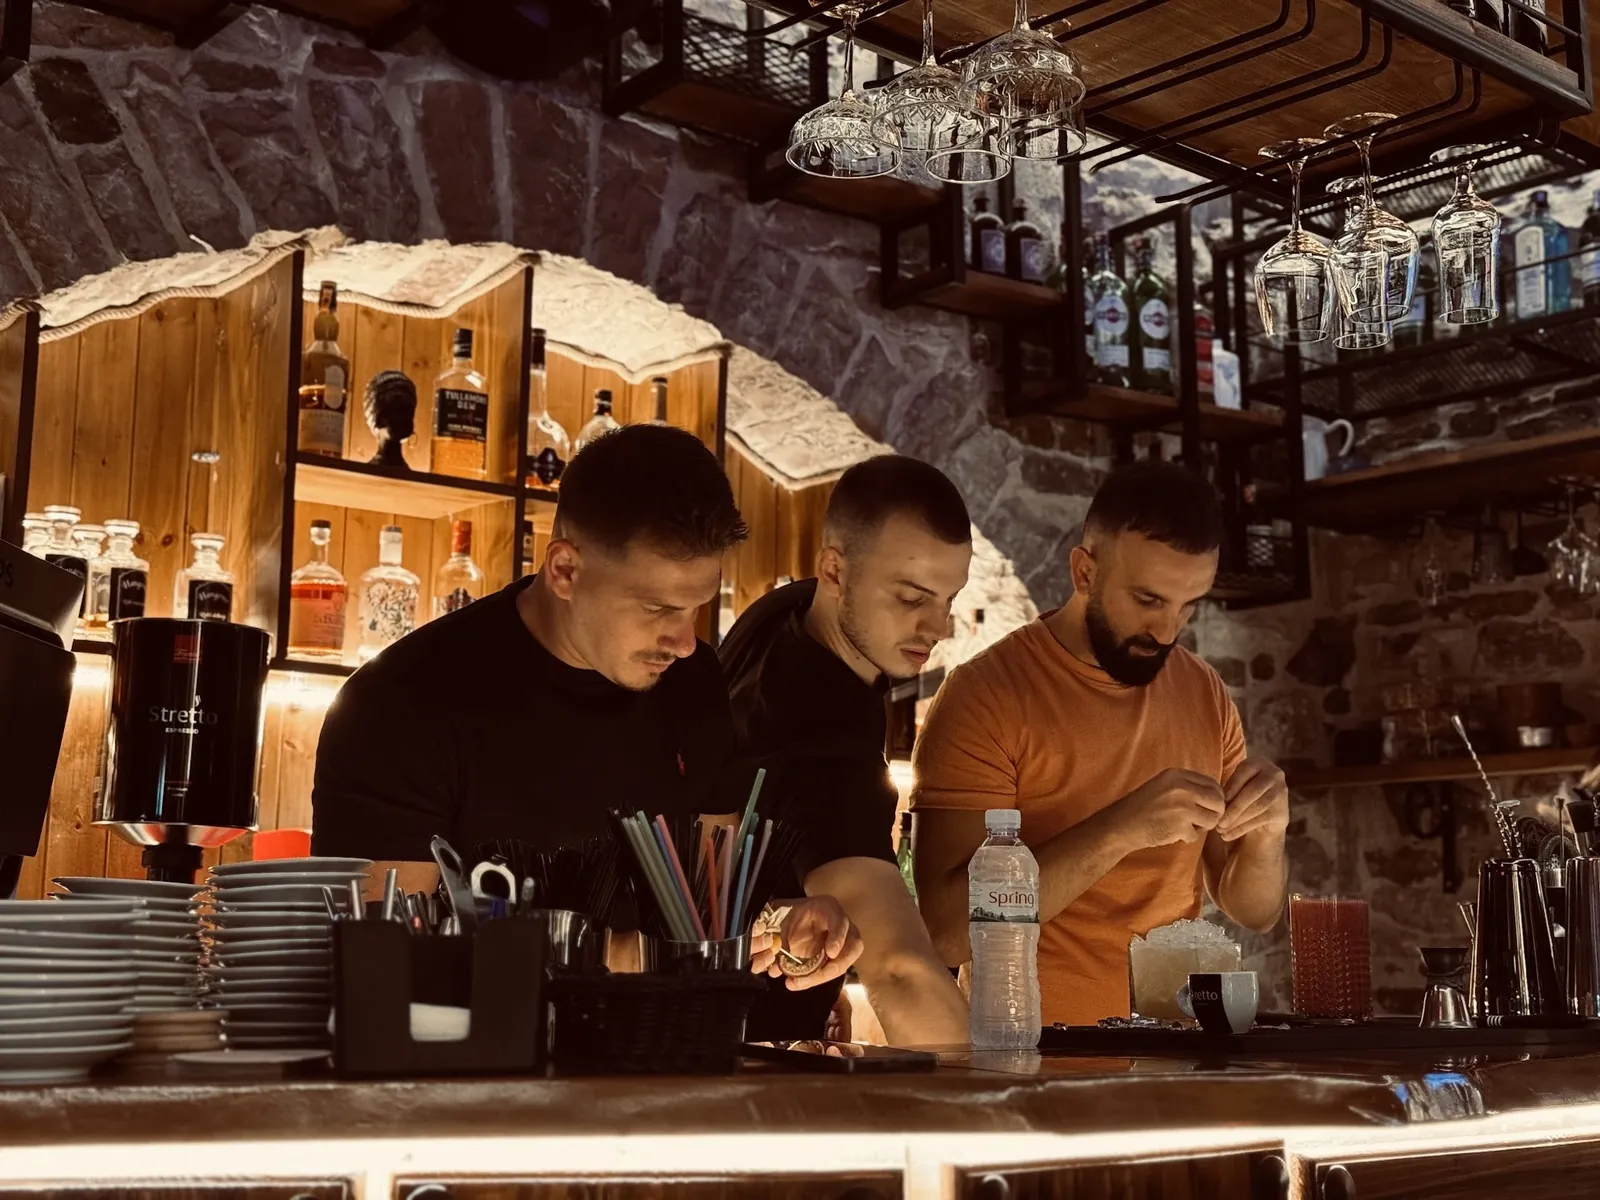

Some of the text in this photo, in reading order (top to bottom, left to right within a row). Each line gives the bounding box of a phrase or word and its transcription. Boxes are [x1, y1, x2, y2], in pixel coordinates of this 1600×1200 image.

[149, 706, 219, 725] Stretto
[988, 891, 1035, 908] Spring
[1190, 989, 1218, 1001] retto
